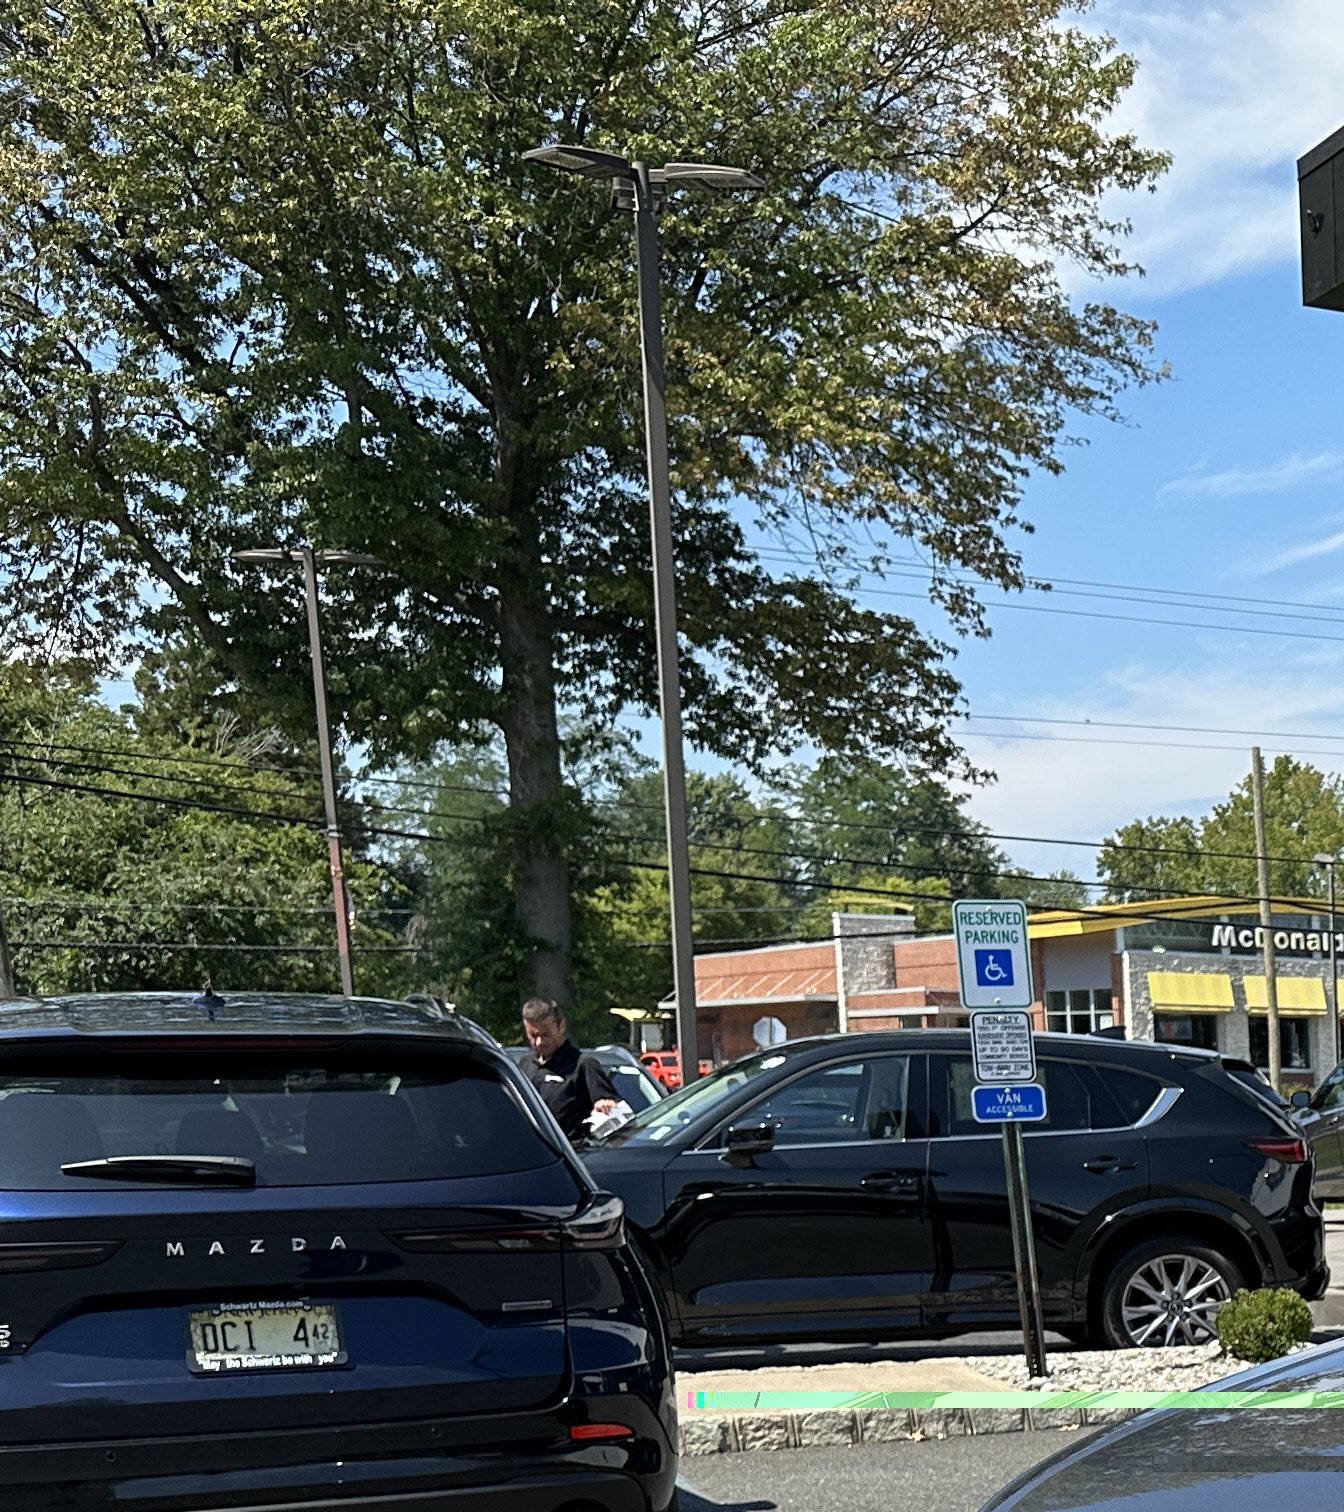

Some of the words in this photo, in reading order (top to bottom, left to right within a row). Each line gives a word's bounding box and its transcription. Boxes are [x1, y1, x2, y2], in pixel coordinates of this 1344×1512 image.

[960, 911, 1022, 926] RESERVED
[965, 930, 1019, 944] PARKING
[996, 1093, 1021, 1104] VAN
[986, 1104, 1034, 1114] ACCESSIBLE
[166, 1235, 347, 1257] MAZDA
